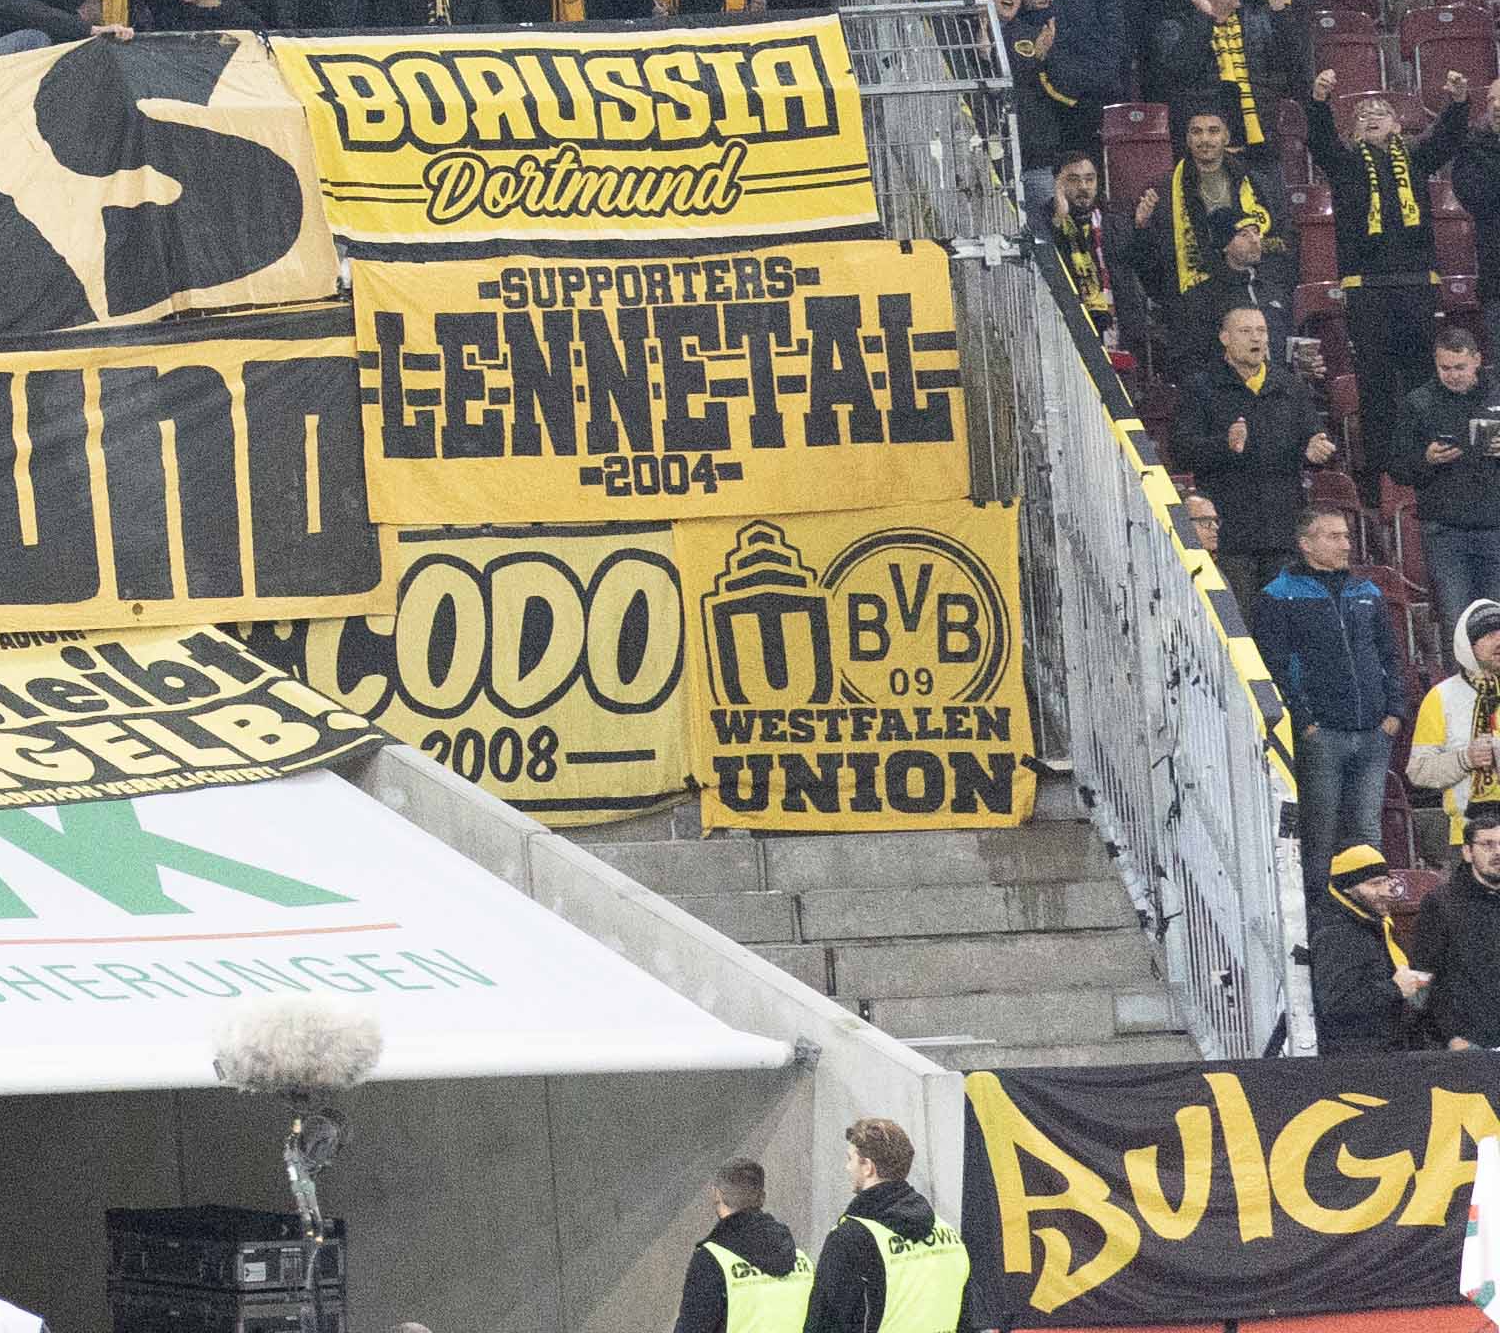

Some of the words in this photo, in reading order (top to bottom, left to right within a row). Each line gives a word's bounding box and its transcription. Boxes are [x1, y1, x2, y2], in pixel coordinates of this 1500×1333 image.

[312, 39, 838, 150] BORUSSIA
[424, 139, 746, 223] Dortmund
[502, 257, 795, 308] SUPPORTERS
[375, 294, 953, 460] LENNETAL
[605, 453, 718, 496] 2004
[848, 563, 981, 664] BVB
[890, 668, 932, 695] 09
[711, 706, 1012, 744] WESTFALEN
[422, 728, 557, 785] 2008
[713, 752, 1017, 814] UNION
